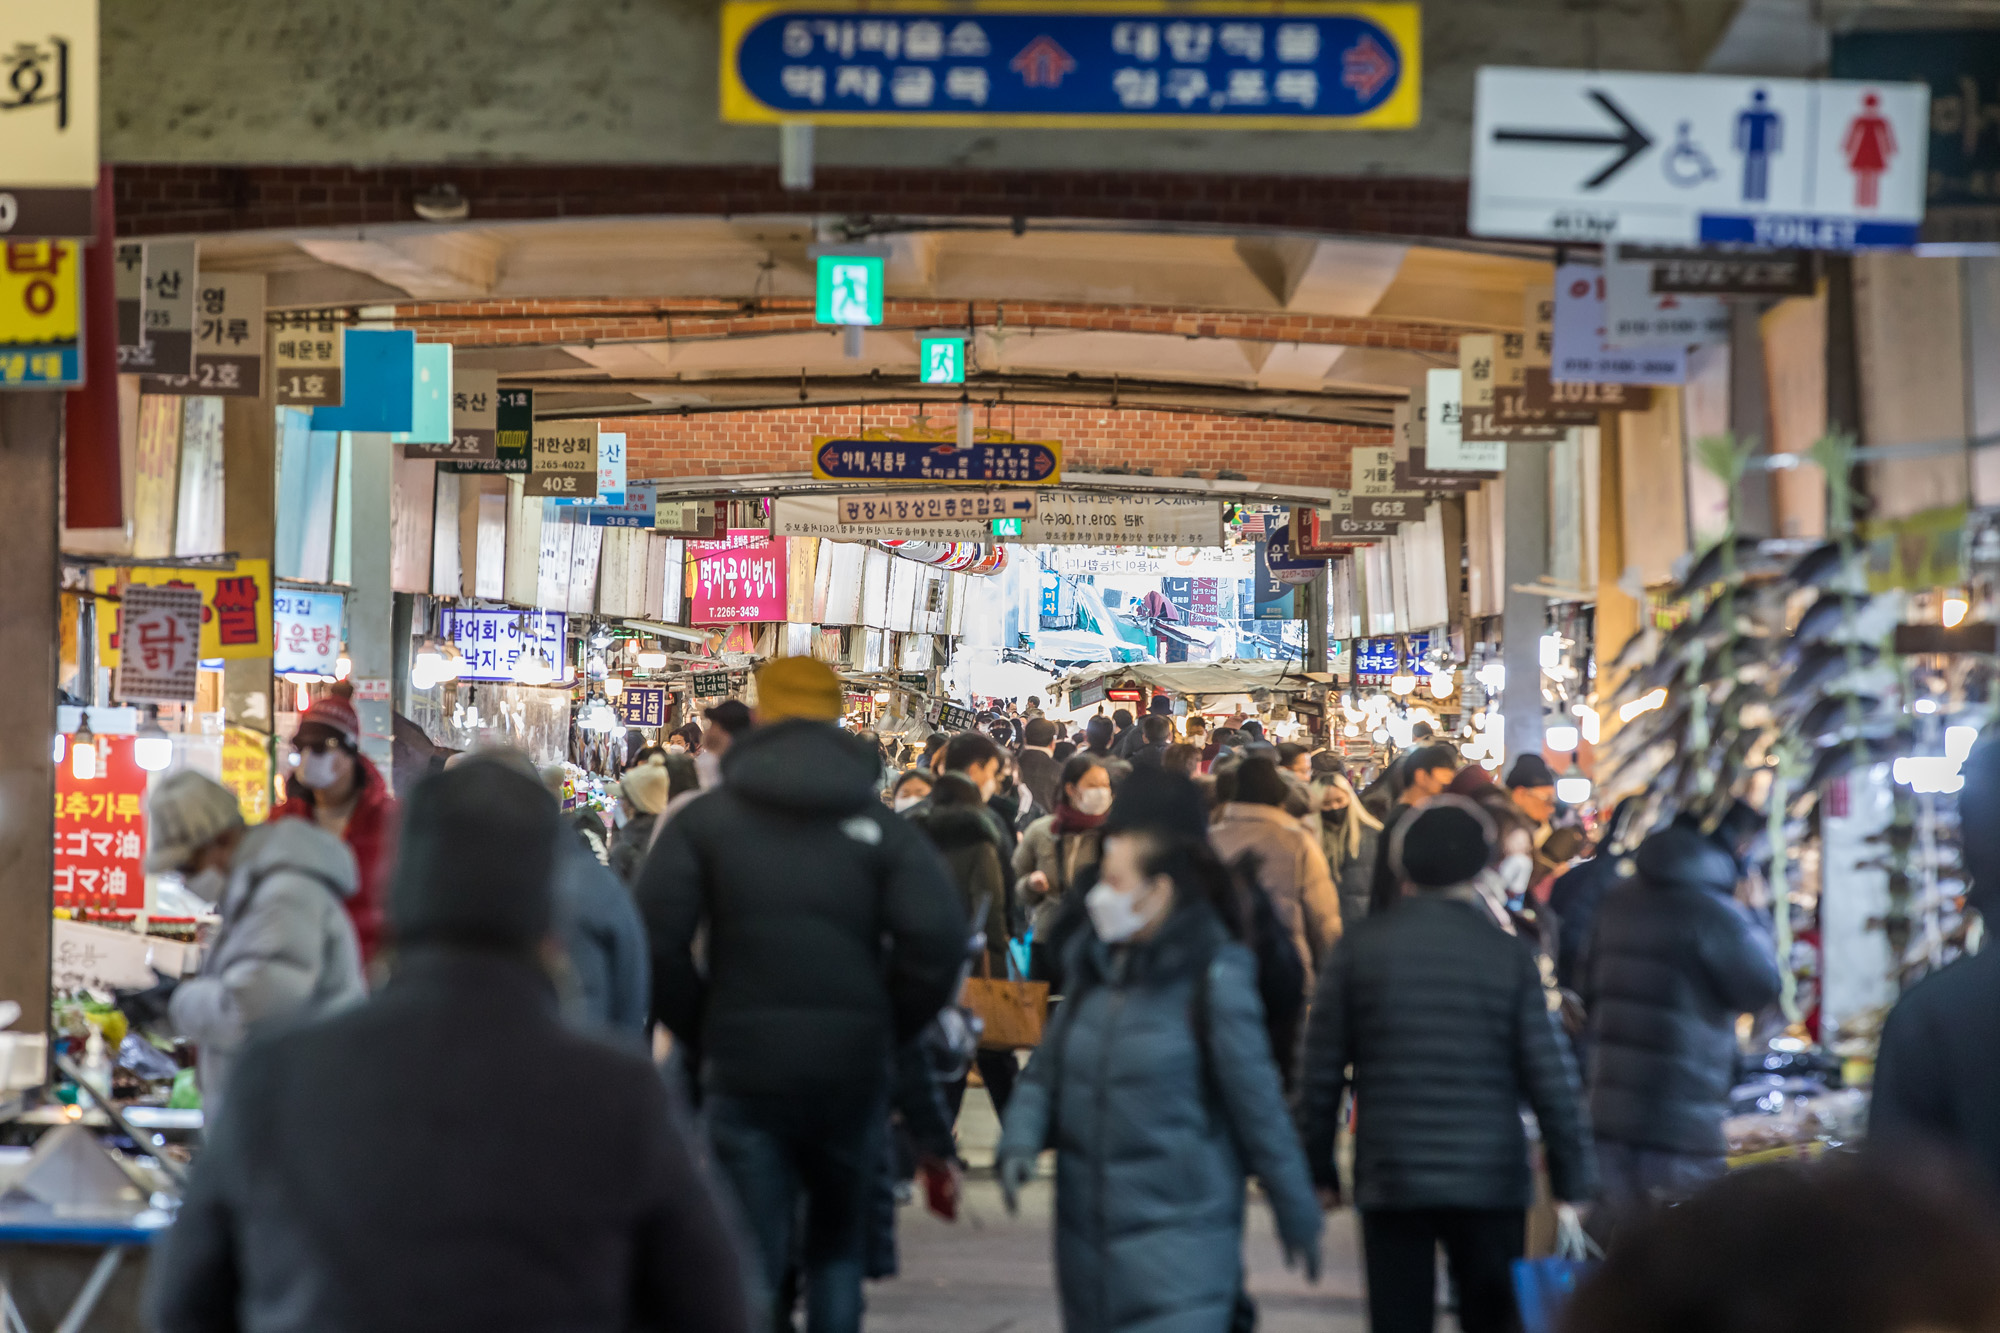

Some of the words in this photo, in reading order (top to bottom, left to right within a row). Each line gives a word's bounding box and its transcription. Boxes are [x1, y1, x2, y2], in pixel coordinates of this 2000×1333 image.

[780, 65, 991, 107] 먹자골목
[278, 339, 333, 361] 매운탕
[534, 436, 592, 454] 대한상회
[542, 476, 578, 492] 40호
[846, 497, 1007, 521] 광장시장상인총연합회
[1371, 501, 1406, 516] 66호
[606, 516, 640, 527] 38호
[708, 606, 760, 618] T.2266-3439
[274, 621, 336, 657] 운탕
